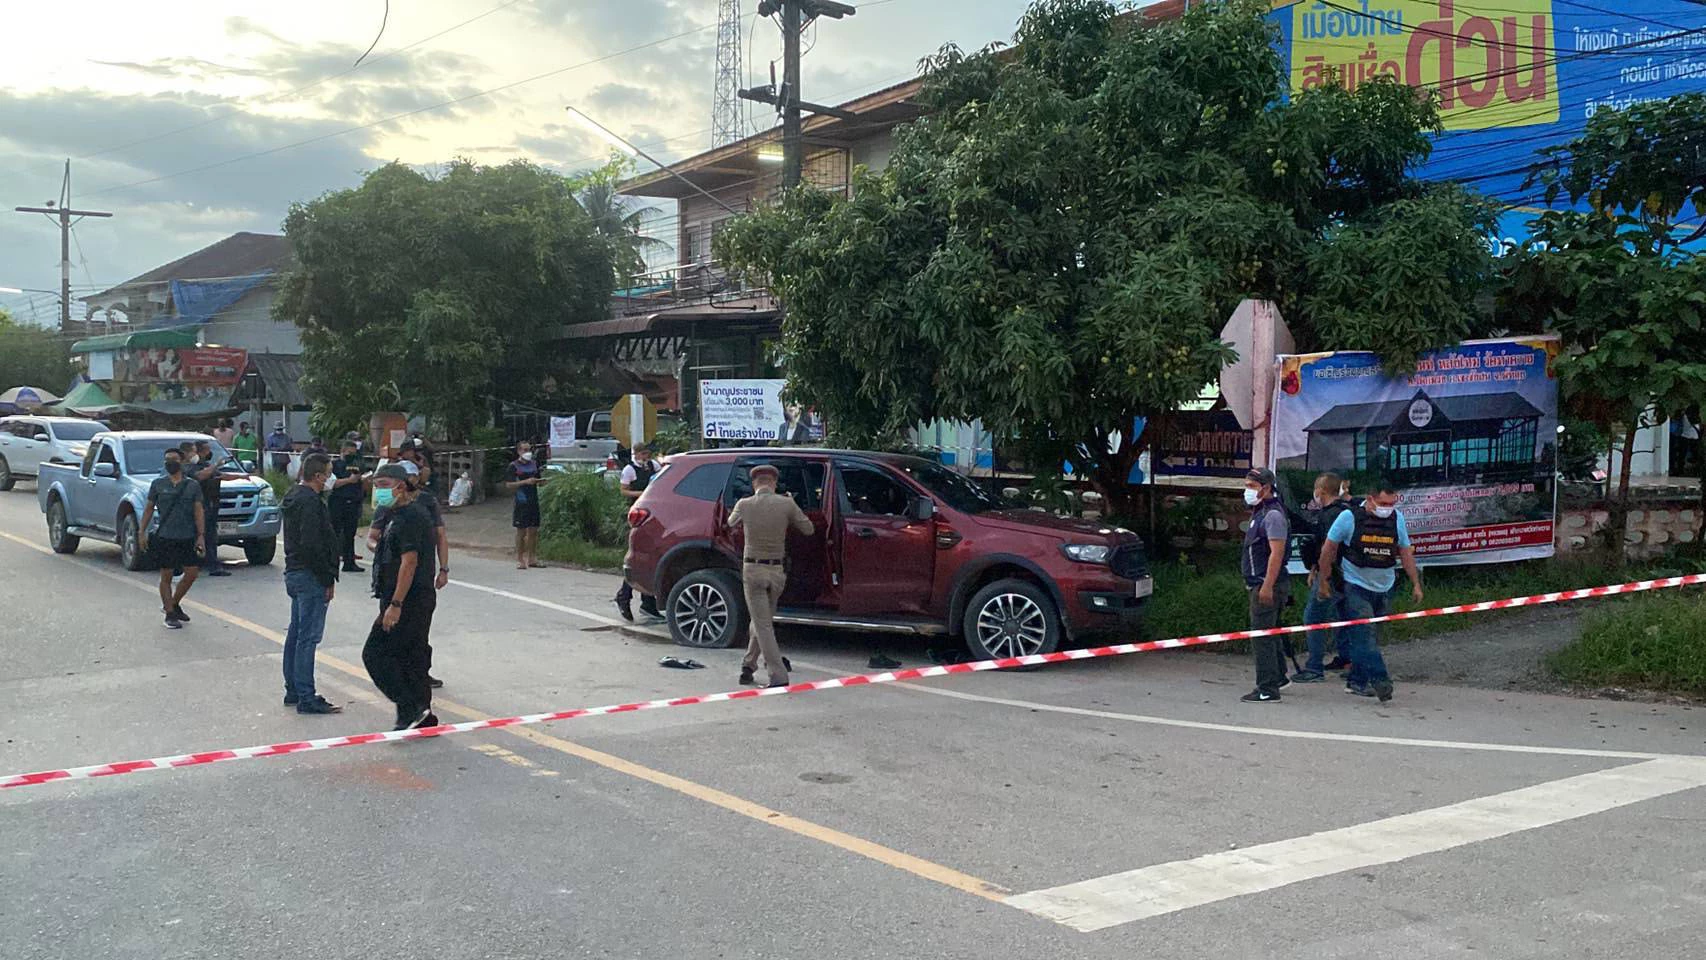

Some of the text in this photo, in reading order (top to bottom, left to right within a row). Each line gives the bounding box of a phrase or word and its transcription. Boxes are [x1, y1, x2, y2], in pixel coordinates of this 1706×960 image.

[1303, 0, 1403, 39] เมืองไทย
[1405, 0, 1546, 110] ด่วน
[703, 386, 763, 397] บำนาญประชาชน
[725, 397, 748, 406] 3,000
[749, 397, 764, 406] บาท
[718, 426, 775, 438] ไทยสร้างไทย
[1187, 457, 1197, 466] 3
[1363, 547, 1391, 556] POLICE
